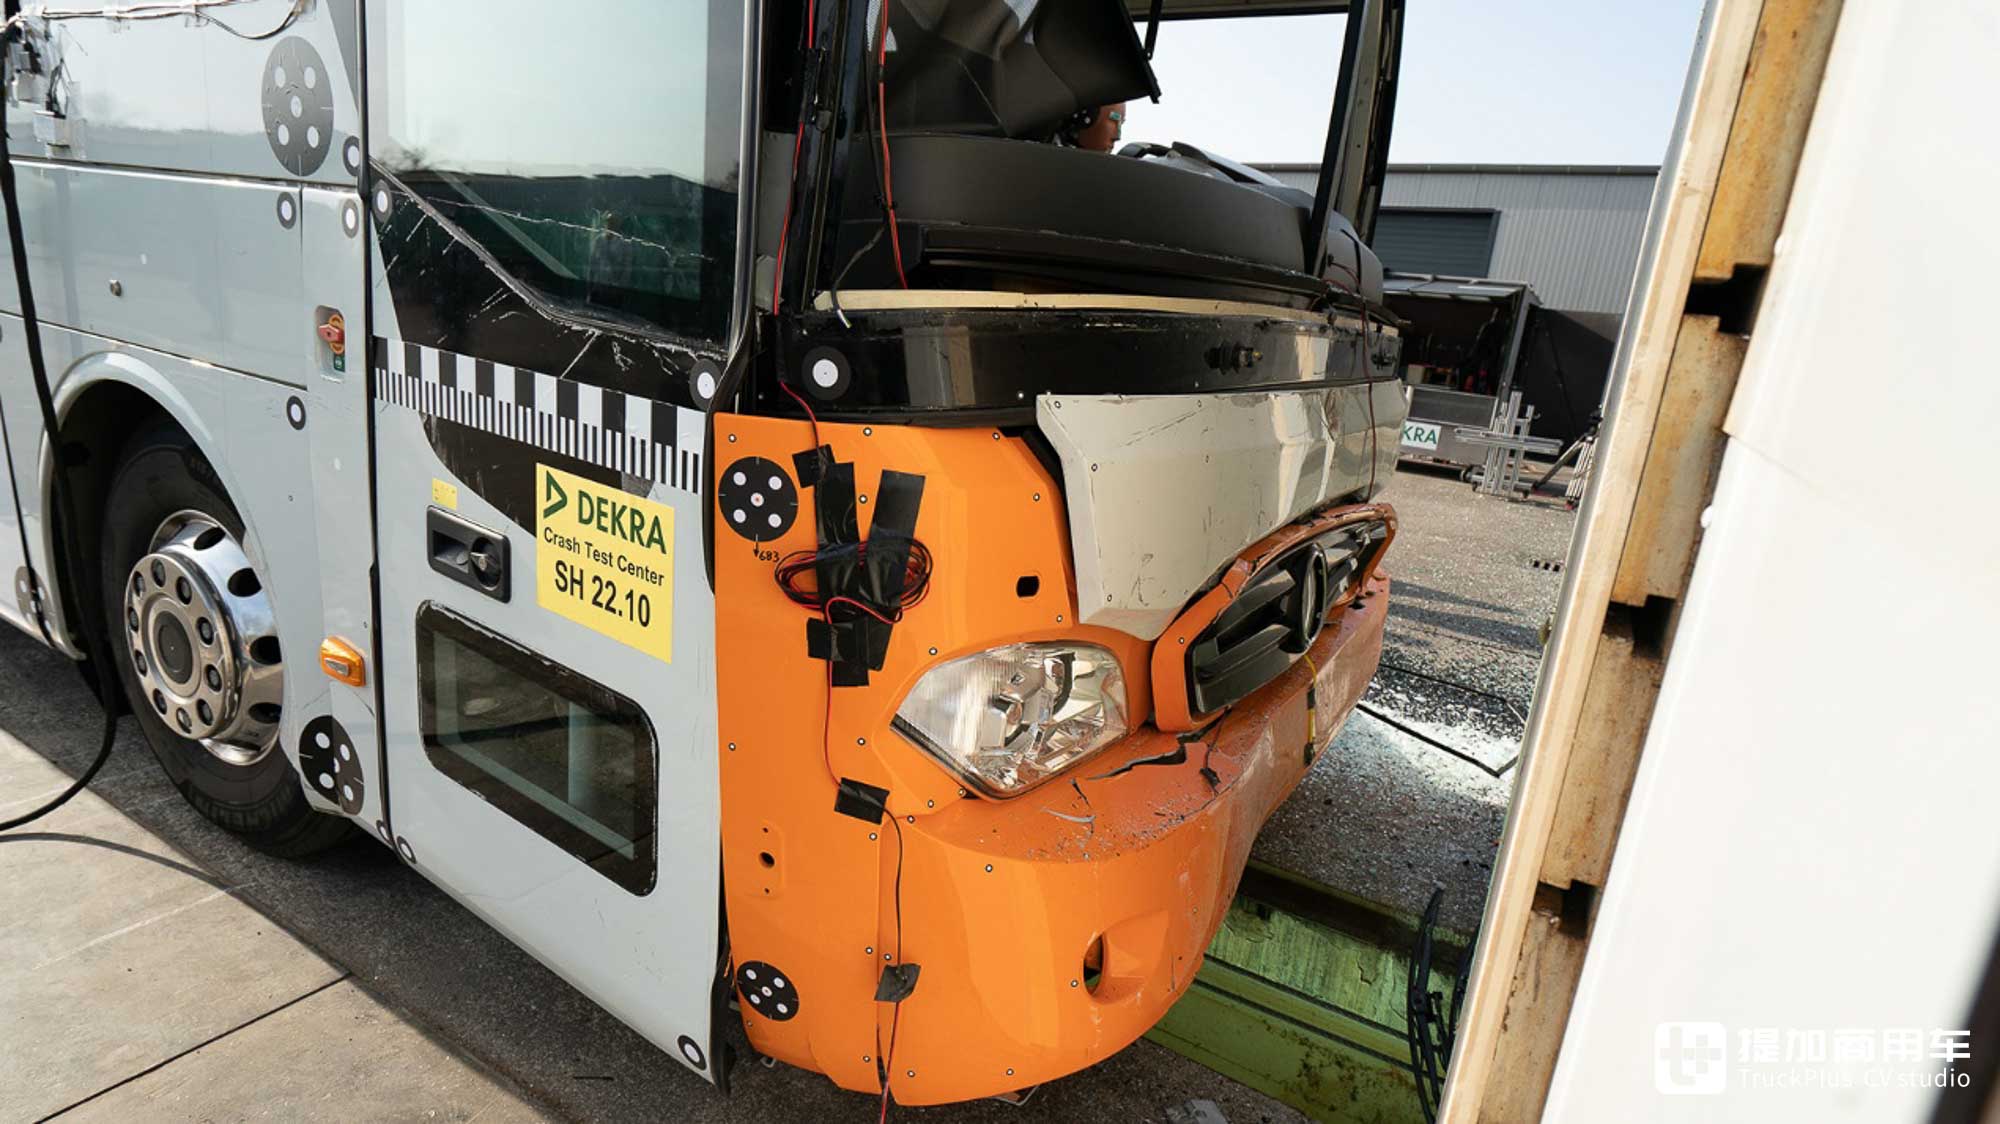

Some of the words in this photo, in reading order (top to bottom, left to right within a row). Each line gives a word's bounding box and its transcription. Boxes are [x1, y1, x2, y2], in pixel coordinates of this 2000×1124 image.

[578, 490, 667, 554] DEKRA
[544, 526, 580, 554] Crash
[584, 541, 613, 567] Test
[617, 555, 665, 586] Center
[759, 551, 780, 562] 683
[555, 560, 584, 600] SH
[591, 576, 651, 627] 22.10
